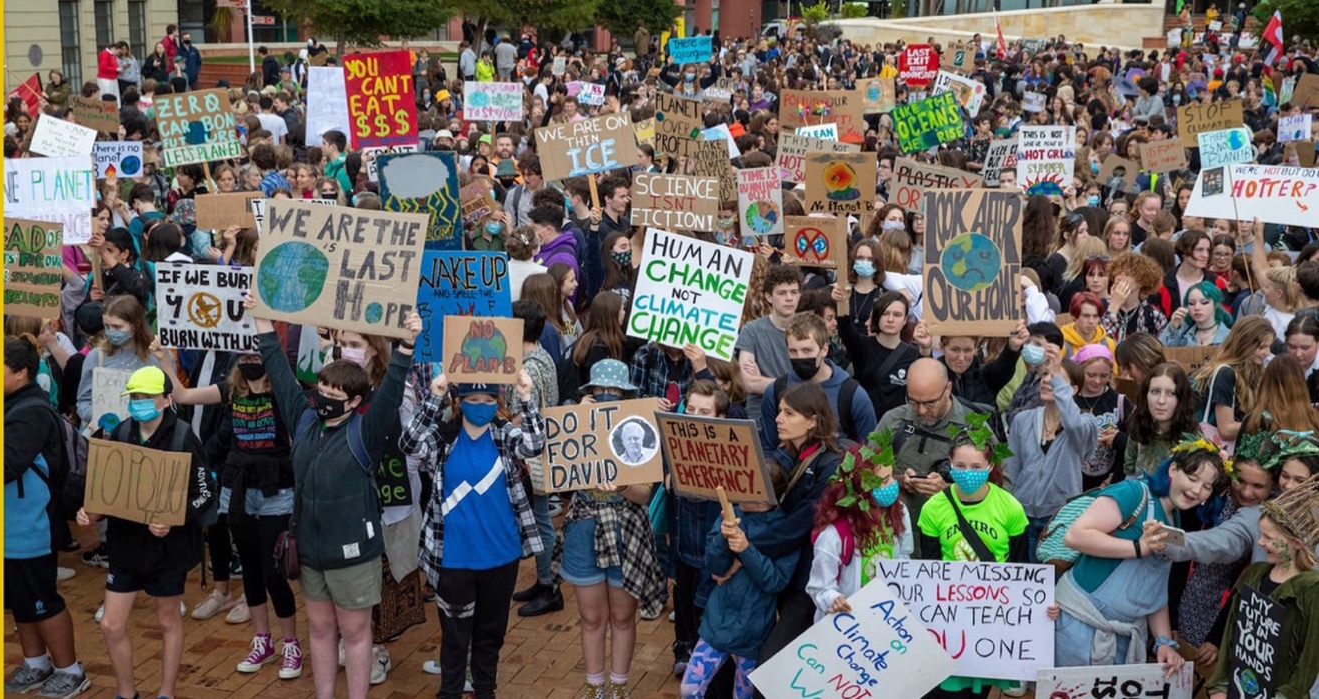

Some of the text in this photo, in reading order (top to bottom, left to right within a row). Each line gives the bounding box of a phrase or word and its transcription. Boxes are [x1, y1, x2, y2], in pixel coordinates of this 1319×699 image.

[907, 48, 931, 57] LAST
[907, 57, 930, 66] EXIT
[344, 57, 379, 80] YOU
[361, 74, 411, 95] CAN'T
[155, 92, 221, 119] ZERO
[350, 94, 401, 116] EAT
[655, 92, 701, 118] PLANET
[893, 92, 955, 122] LIKE THE
[1185, 102, 1232, 124] STOP
[158, 112, 236, 138] CARBON
[538, 114, 629, 143] WE ARE ON
[662, 118, 690, 137] OVER
[802, 127, 834, 139] CLEAN
[898, 105, 959, 140] OCEANS
[1023, 130, 1063, 139] THIS IS NOT
[1187, 119, 1231, 134] CLIMATE
[118, 143, 125, 153] is
[127, 145, 140, 153] no
[565, 134, 599, 149] THIN
[696, 139, 723, 151] TAKE
[782, 147, 806, 156] WHAT
[783, 135, 849, 152] THIS IS NOT
[901, 126, 964, 154] WE RISE
[1202, 144, 1215, 156] IS
[566, 138, 619, 176] ICE
[779, 154, 806, 170] HOT
[1025, 149, 1045, 160] HOT
[1208, 147, 1245, 167] PLANET
[739, 167, 779, 182] TIME IS
[898, 166, 960, 189] PLASTIC
[1027, 162, 1068, 175] SUMMER
[1264, 167, 1315, 181] HOT BUT DO
[31, 169, 92, 202] PLANET
[635, 174, 719, 200] SCIENCE
[739, 180, 781, 194] RUNNING
[1230, 177, 1317, 198] HOTTER?
[828, 200, 861, 212] Planet
[897, 186, 921, 210] OR
[269, 205, 311, 238] WE
[317, 213, 370, 245] ARE
[373, 218, 421, 246] THE
[630, 207, 715, 231] FICTION!
[924, 190, 1021, 265] LOOK AFTER
[46, 229, 63, 250] OF
[19, 251, 45, 269] FOR
[339, 248, 417, 283] LAST
[651, 233, 743, 278] HUMAN
[157, 269, 253, 290] IF WE BUR
[418, 255, 507, 292] WAKE UP
[645, 260, 748, 304] CHANGE
[334, 280, 413, 331] HOPE
[433, 289, 450, 300] AND
[479, 289, 496, 299] THE
[671, 287, 702, 304] NOT
[927, 265, 1020, 322] OUR HOME
[634, 294, 738, 332] CLIMATE
[159, 328, 261, 352] BURN WITH US
[469, 320, 496, 341] NO
[630, 312, 735, 359] CHANGE
[449, 353, 517, 374] PLAN B
[545, 405, 619, 441] DO IT
[729, 427, 740, 442] A
[547, 433, 599, 465] FOR
[668, 437, 749, 467] PLANETARY
[90, 442, 125, 506] TO
[550, 458, 619, 489] DAVID
[675, 463, 762, 495] EMERGENCY.
[879, 561, 1048, 585] WE ARE MISSING
[936, 584, 1011, 606] LESSONS
[1022, 587, 1047, 607] SO
[1251, 592, 1273, 616] MY
[870, 599, 913, 644] Action
[919, 604, 1033, 627] CAN TEACH
[1239, 599, 1281, 637] FUTURE
[832, 612, 890, 671] Climate
[1237, 620, 1274, 665] YOUR
[1256, 625, 1269, 641] IN
[890, 639, 908, 655] on
[974, 637, 1036, 661] ONE
[797, 643, 872, 699] Can NOT
[836, 643, 879, 687] Change
[1235, 644, 1272, 682] HANDS
